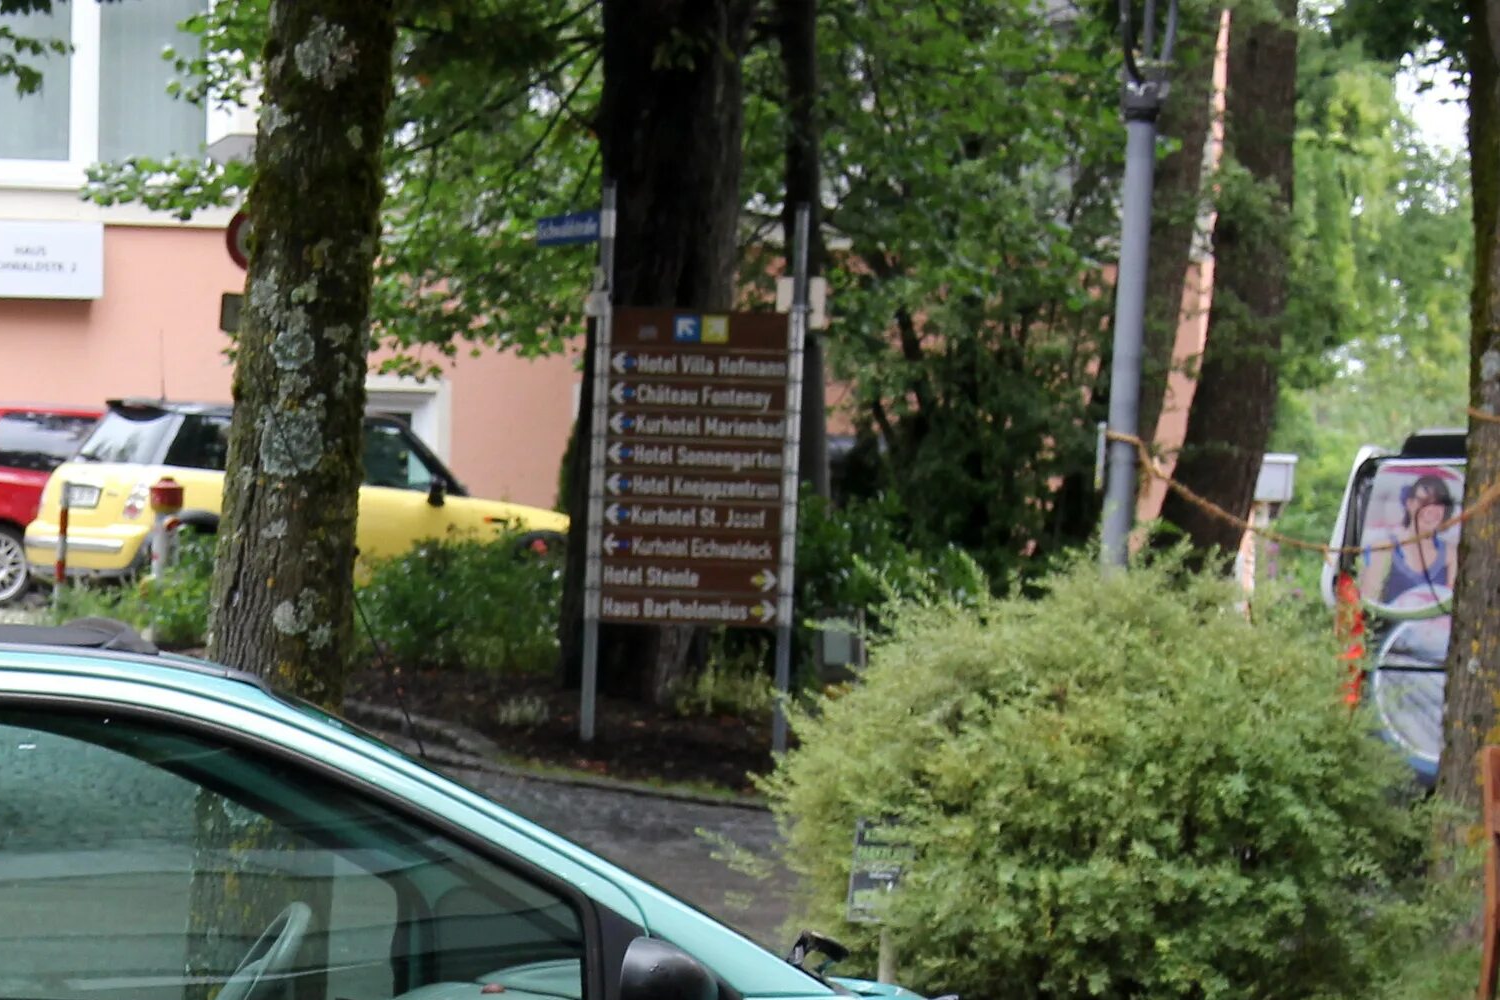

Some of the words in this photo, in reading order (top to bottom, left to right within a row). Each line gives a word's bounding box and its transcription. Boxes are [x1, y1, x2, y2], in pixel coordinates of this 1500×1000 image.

[14, 246, 47, 257] HAUS
[637, 353, 677, 373] Hotel
[681, 354, 714, 374] Villa
[718, 356, 786, 377] Hofmann
[637, 383, 698, 404] Château
[702, 386, 772, 412] Fontenay
[635, 414, 700, 436] Kurhotel
[704, 416, 786, 438] Marienbad
[634, 444, 673, 465] Hotel
[677, 446, 782, 472] Sonnengarten
[632, 474, 670, 495] Hotel
[673, 476, 780, 501] Kneippzentrum
[631, 504, 696, 525] Kurhotel
[699, 507, 721, 528] St.
[724, 508, 766, 529] Josef
[631, 535, 689, 557] Kurhotel
[691, 537, 772, 560] Eichwaldeck
[603, 565, 643, 585] Hotel
[646, 567, 700, 588] Steinle
[602, 596, 639, 617] Haus
[643, 598, 748, 621] Bartholomäus
